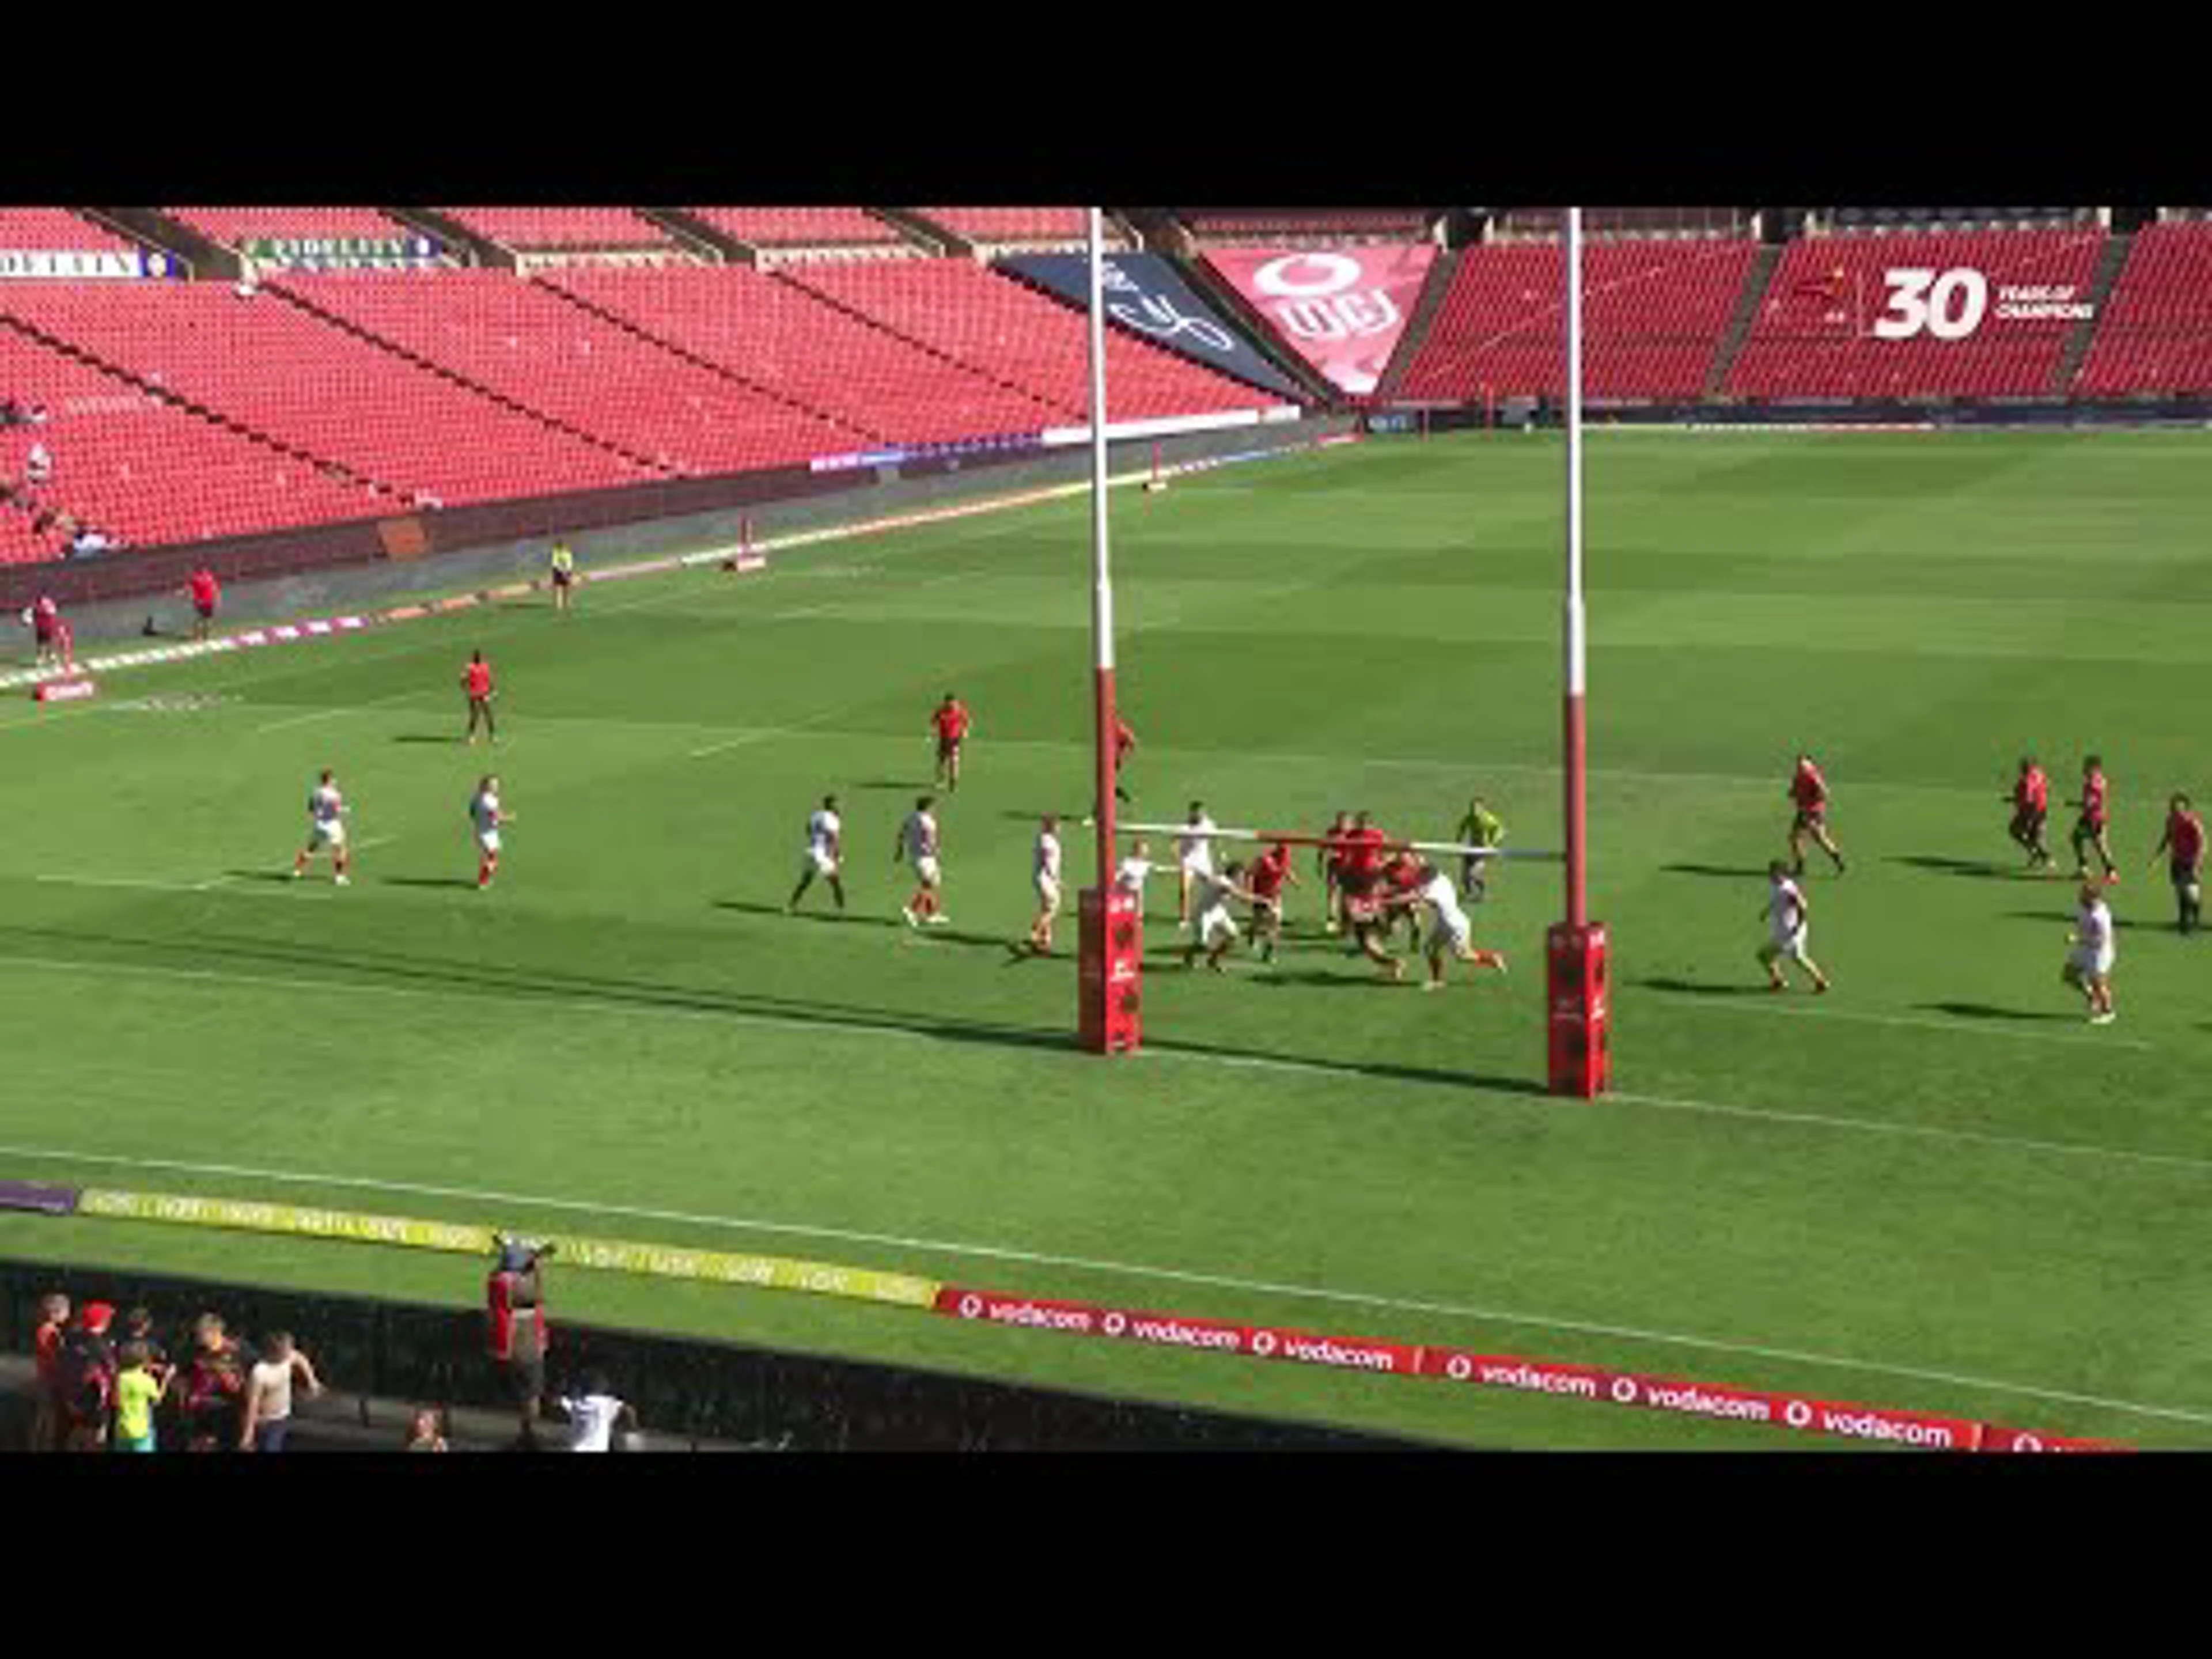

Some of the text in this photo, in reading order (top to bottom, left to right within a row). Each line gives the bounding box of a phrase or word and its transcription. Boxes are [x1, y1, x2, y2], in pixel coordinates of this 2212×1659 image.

[1873, 267, 1987, 339] 30
[989, 1302, 1393, 1370] vodacom vodacom vodacom
[1482, 1363, 1953, 1448] vodacom vodacom vodacom
